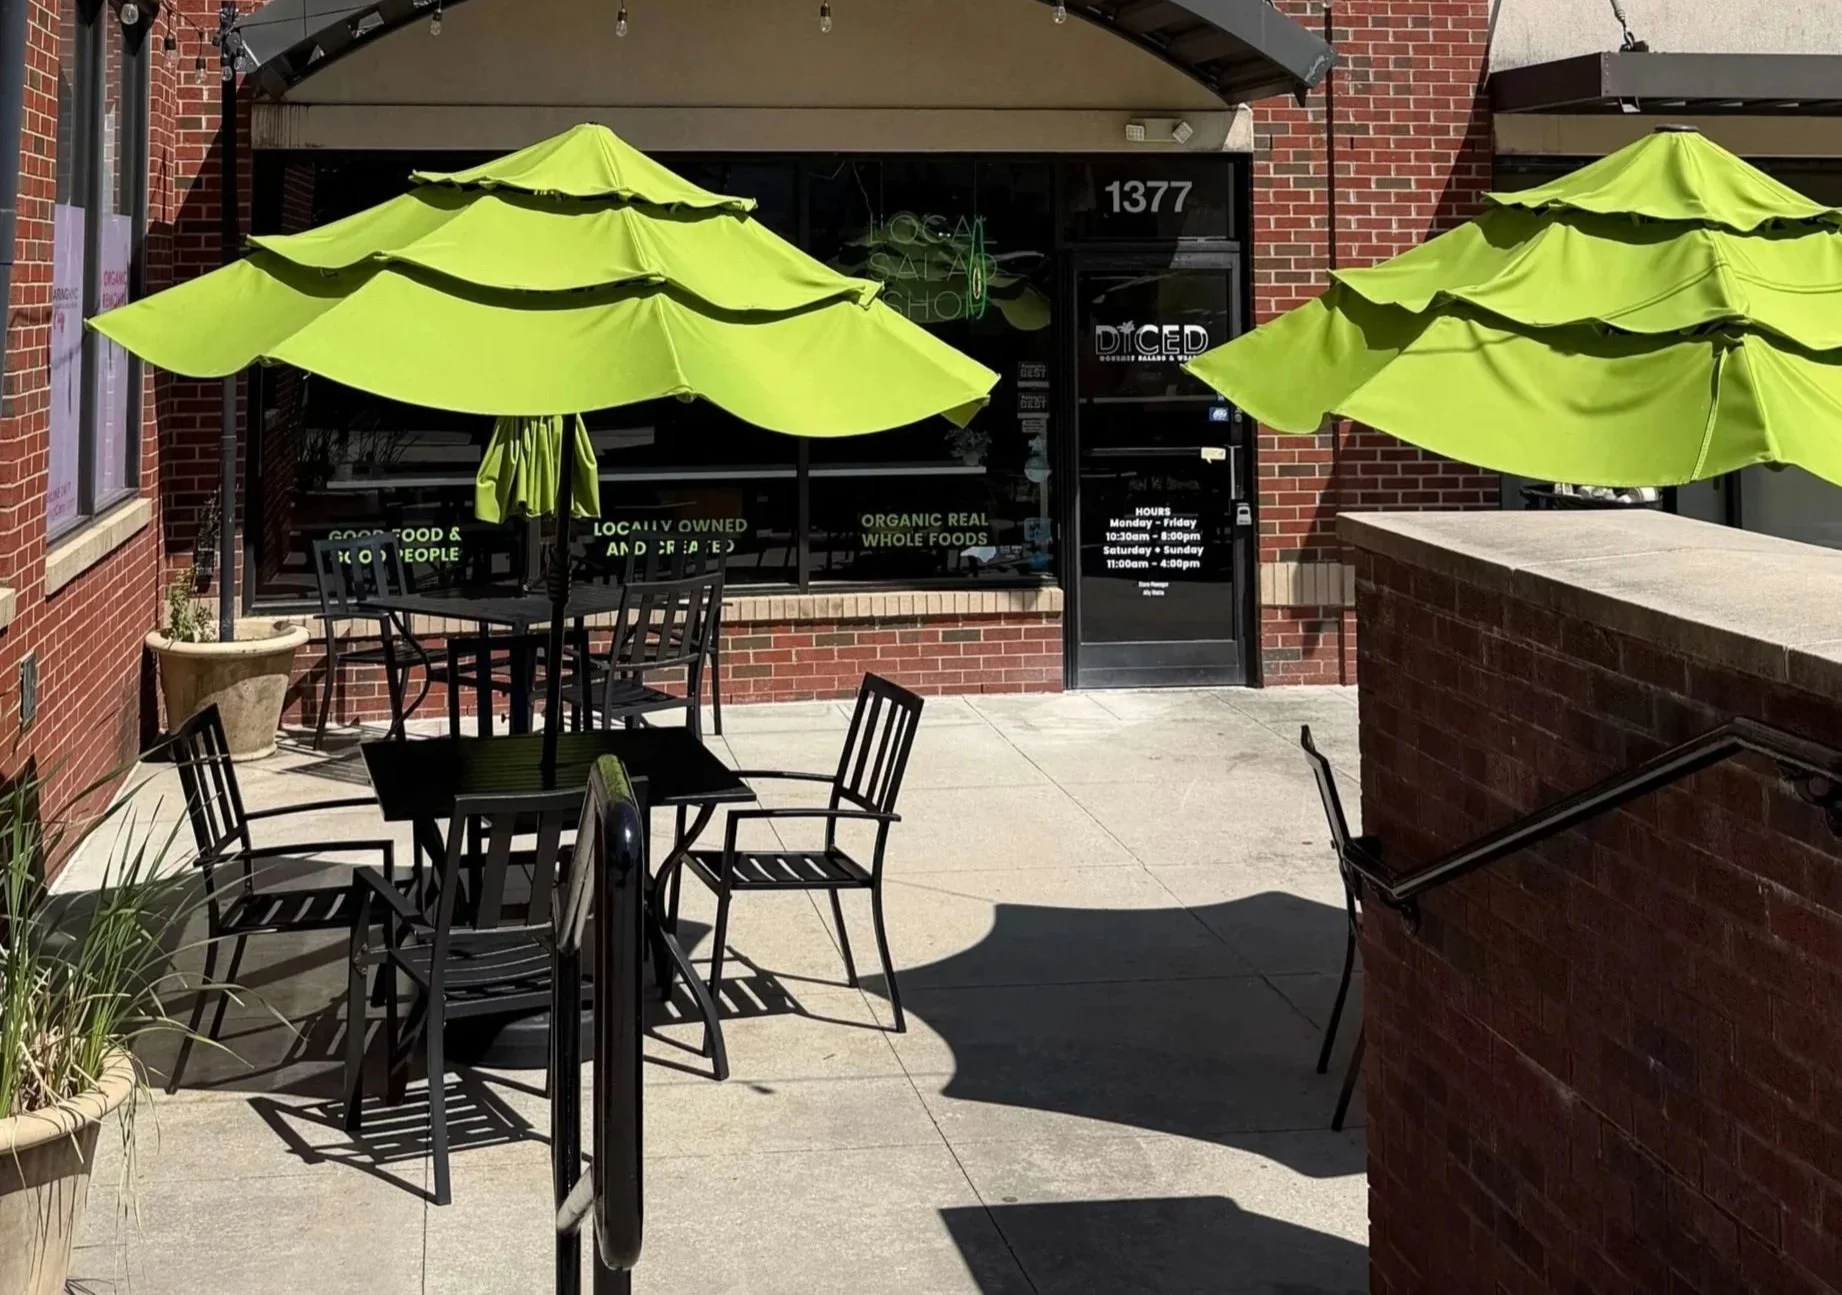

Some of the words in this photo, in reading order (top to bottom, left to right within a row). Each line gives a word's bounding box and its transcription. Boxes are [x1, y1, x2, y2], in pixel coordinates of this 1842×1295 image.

[1104, 180, 1192, 213] 1377
[870, 215, 998, 244] LOCAL
[870, 253, 998, 281] SALAD
[1095, 320, 1209, 355] DICED
[1135, 507, 1171, 516] HOURS
[594, 519, 672, 536] LOCALLY
[678, 518, 748, 533] OWNED
[861, 513, 942, 527] ORGANIC
[948, 512, 989, 527] REAL
[1110, 518, 1152, 530] Monday
[1163, 518, 1197, 530] Friday
[449, 526, 462, 541] &
[861, 533, 923, 547] WHOLE
[929, 532, 988, 546] FOODS
[1105, 532, 1150, 541] 10:30am
[1161, 531, 1201, 543] 8:00pm
[606, 541, 647, 556] AND
[1103, 545, 1152, 557] Saturday
[1163, 545, 1204, 557] Sunday
[1106, 560, 1149, 568] 11:00am
[1160, 559, 1200, 571] 4:00pm
